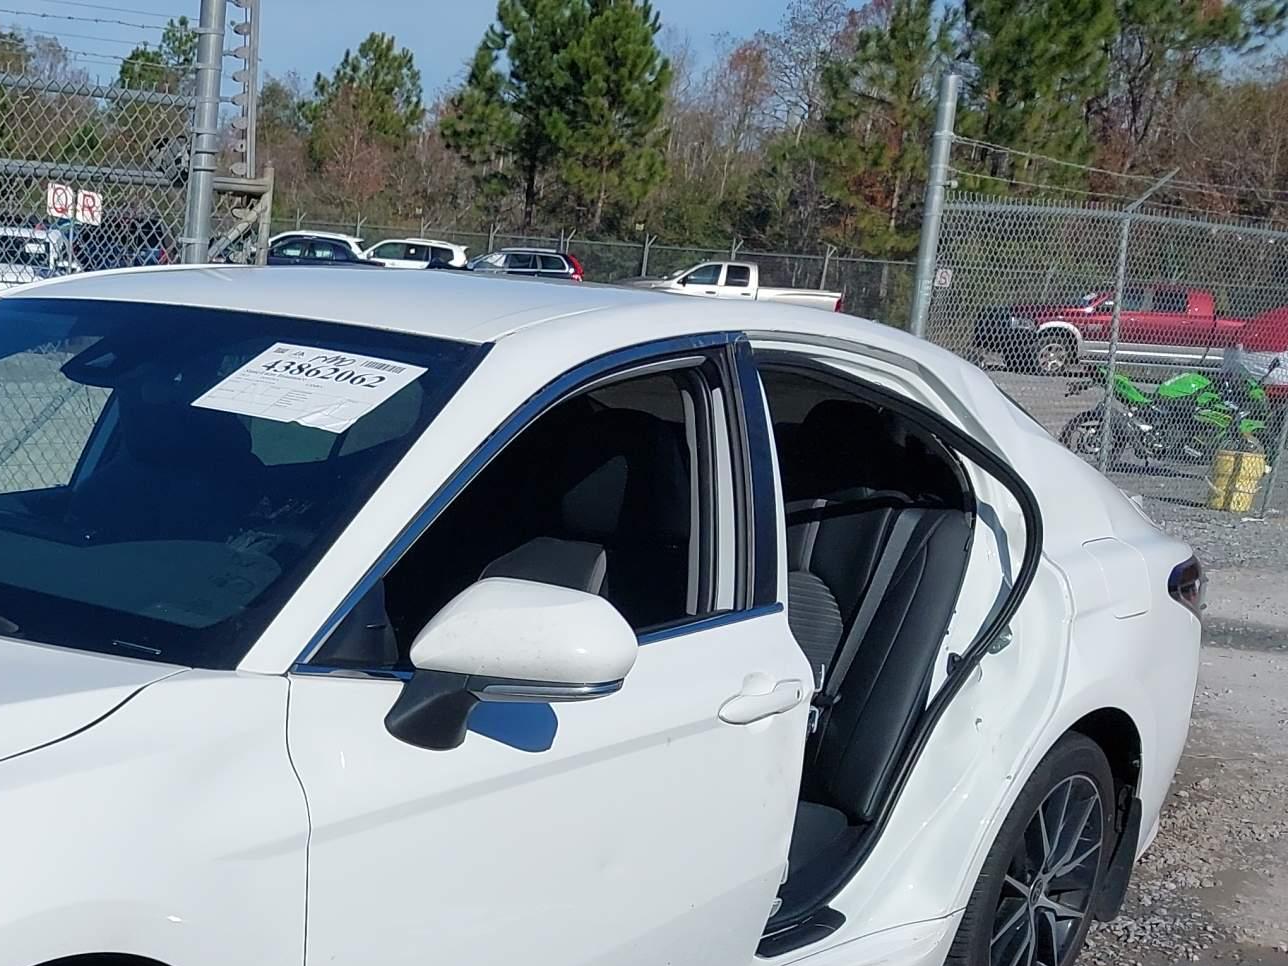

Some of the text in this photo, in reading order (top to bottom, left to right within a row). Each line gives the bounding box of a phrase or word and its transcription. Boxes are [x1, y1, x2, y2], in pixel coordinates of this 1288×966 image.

[53, 187, 68, 214] Q
[82, 194, 96, 221] R
[262, 360, 386, 388] 43862062
